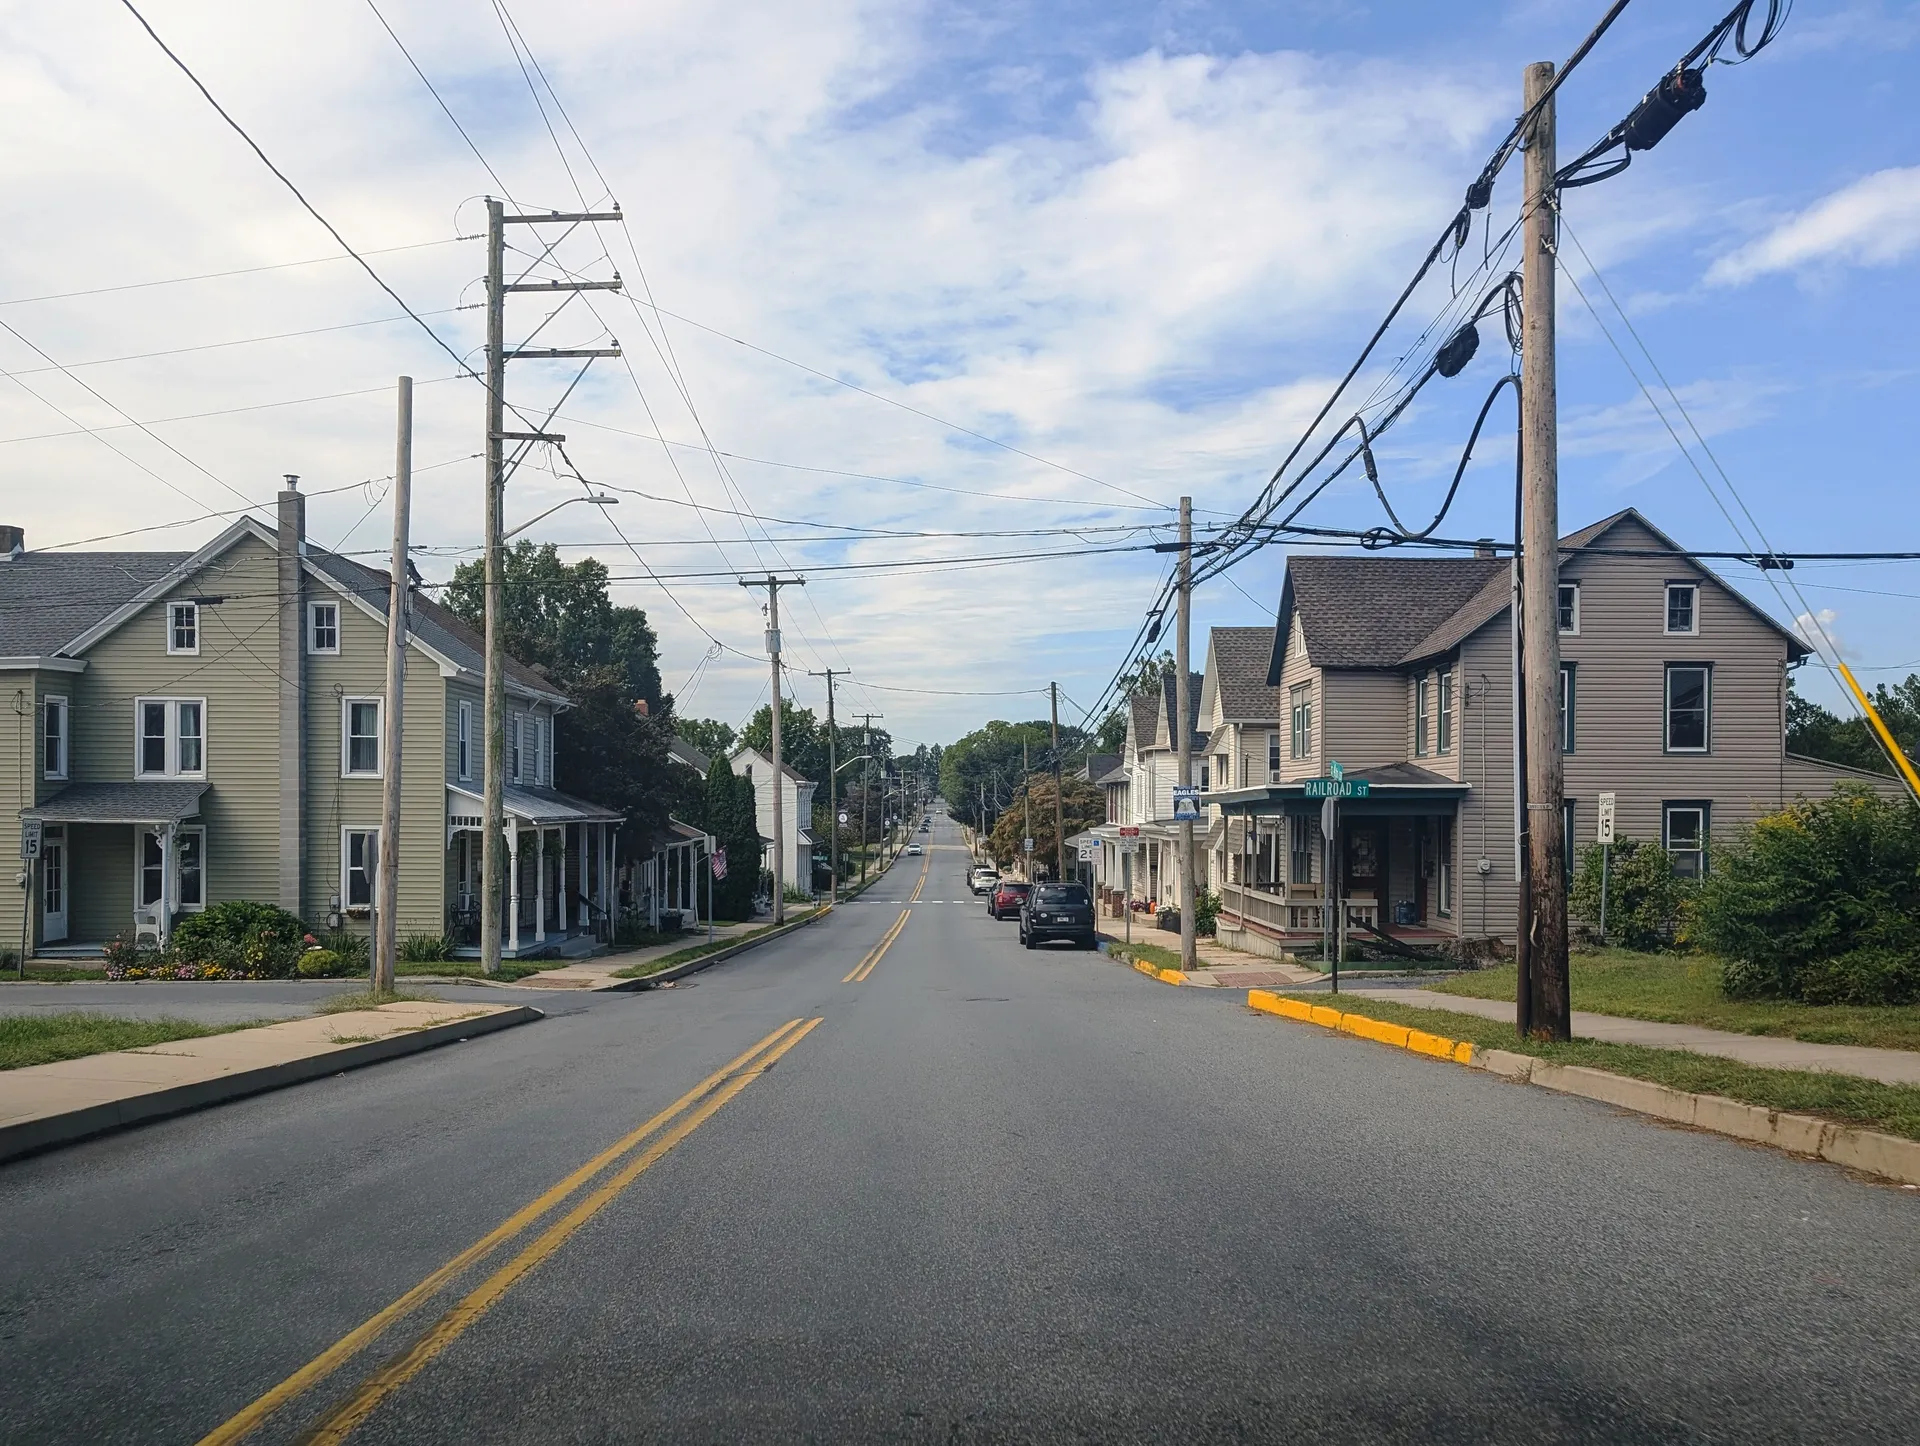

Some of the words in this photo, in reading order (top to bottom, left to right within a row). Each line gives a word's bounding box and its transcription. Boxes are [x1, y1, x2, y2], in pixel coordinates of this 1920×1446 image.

[1305, 782, 1352, 796] RAILROAD
[1357, 786, 1367, 796] ST
[1600, 797, 1613, 806] SPEED
[1601, 808, 1612, 817] LIMIT
[1601, 819, 1611, 838] 15
[25, 839, 37, 854] 15
